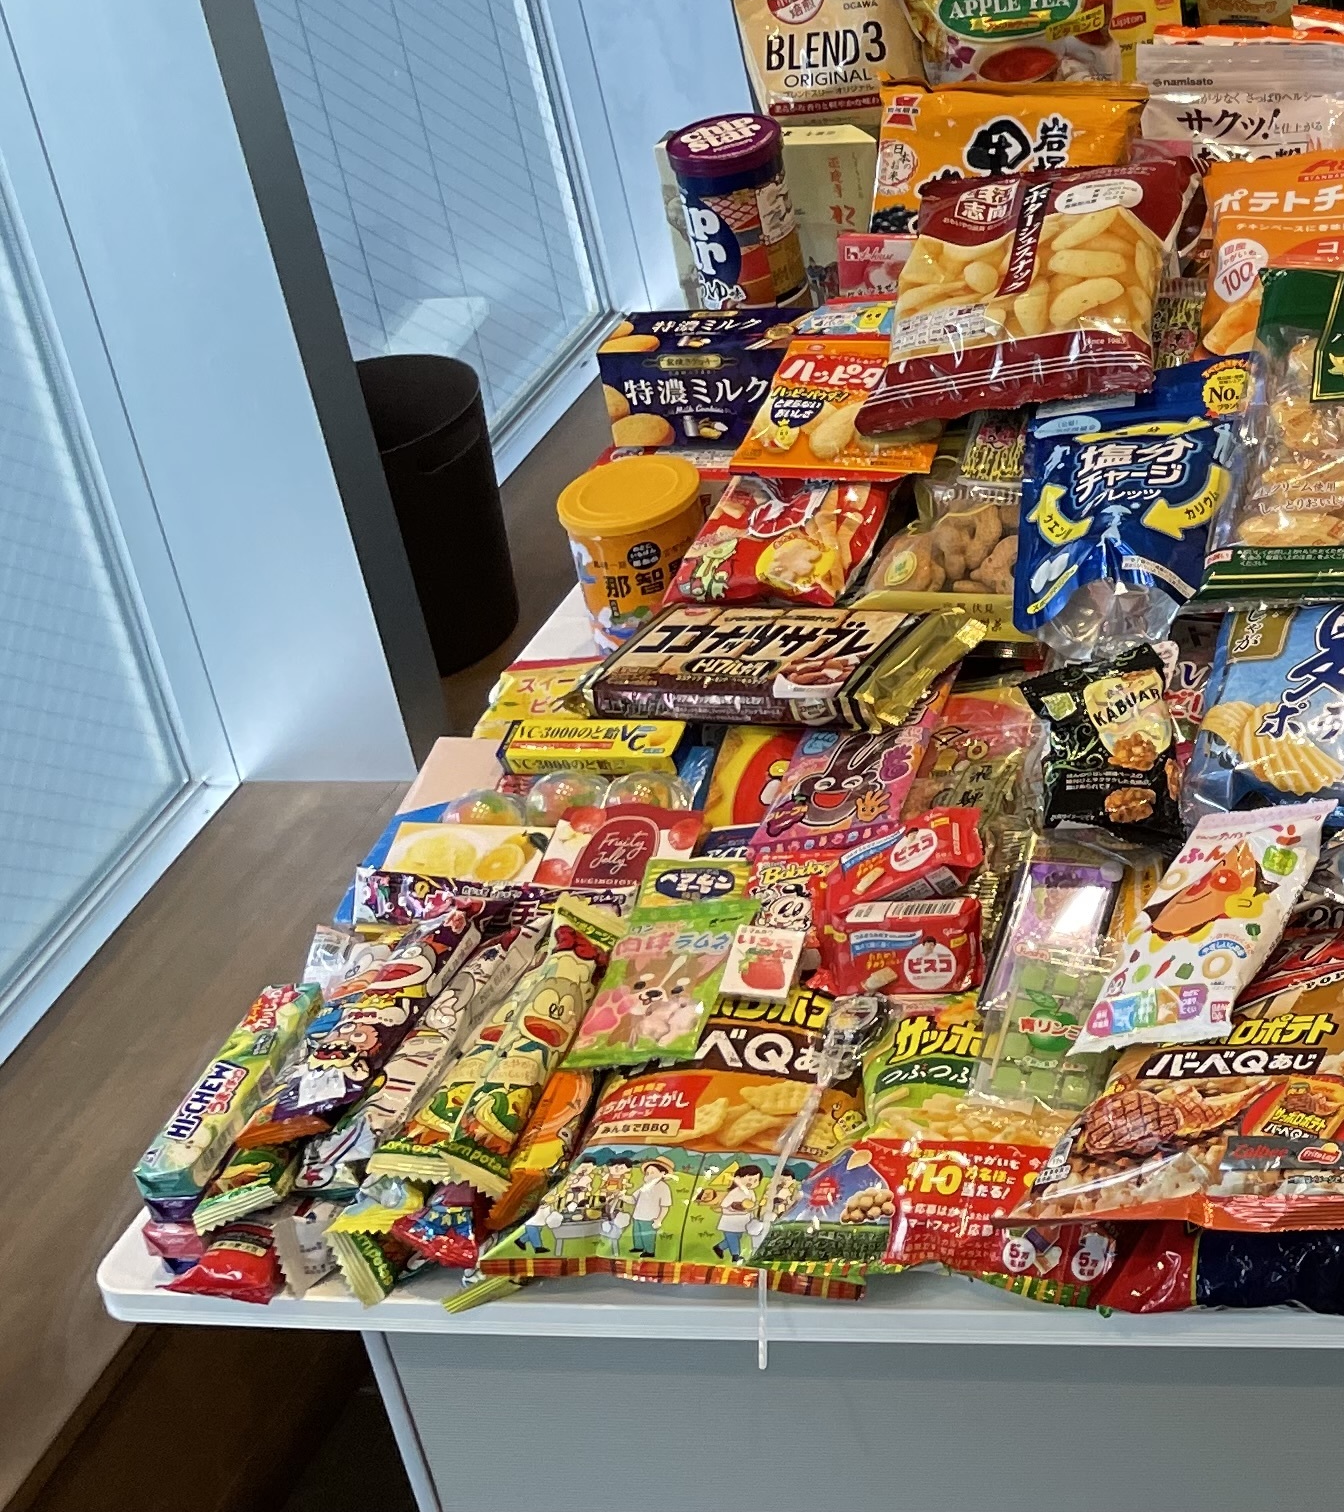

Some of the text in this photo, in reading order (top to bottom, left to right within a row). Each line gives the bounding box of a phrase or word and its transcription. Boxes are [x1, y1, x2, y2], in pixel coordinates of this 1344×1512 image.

[1111, 13, 1144, 28] Lipton
[765, 22, 887, 71] BLEND 3
[784, 69, 873, 89] ORIGINAL
[1163, 76, 1213, 86] namisato
[1007, 181, 1051, 293] ポタージュスナック
[652, 318, 762, 334] 特濃ミルク
[624, 375, 770, 406] 特濃ミルク
[1079, 438, 1194, 473] 塩分
[1076, 460, 1186, 497] チャージ
[597, 828, 646, 852] Fruity
[889, 826, 937, 871] ビスコ
[594, 846, 628, 870] Jelly
[676, 934, 732, 951] ラムネ
[907, 956, 952, 974] ビスコ
[164, 1060, 227, 1139] HI-CHEW
[601, 1121, 670, 1136] みんなでBBQ
